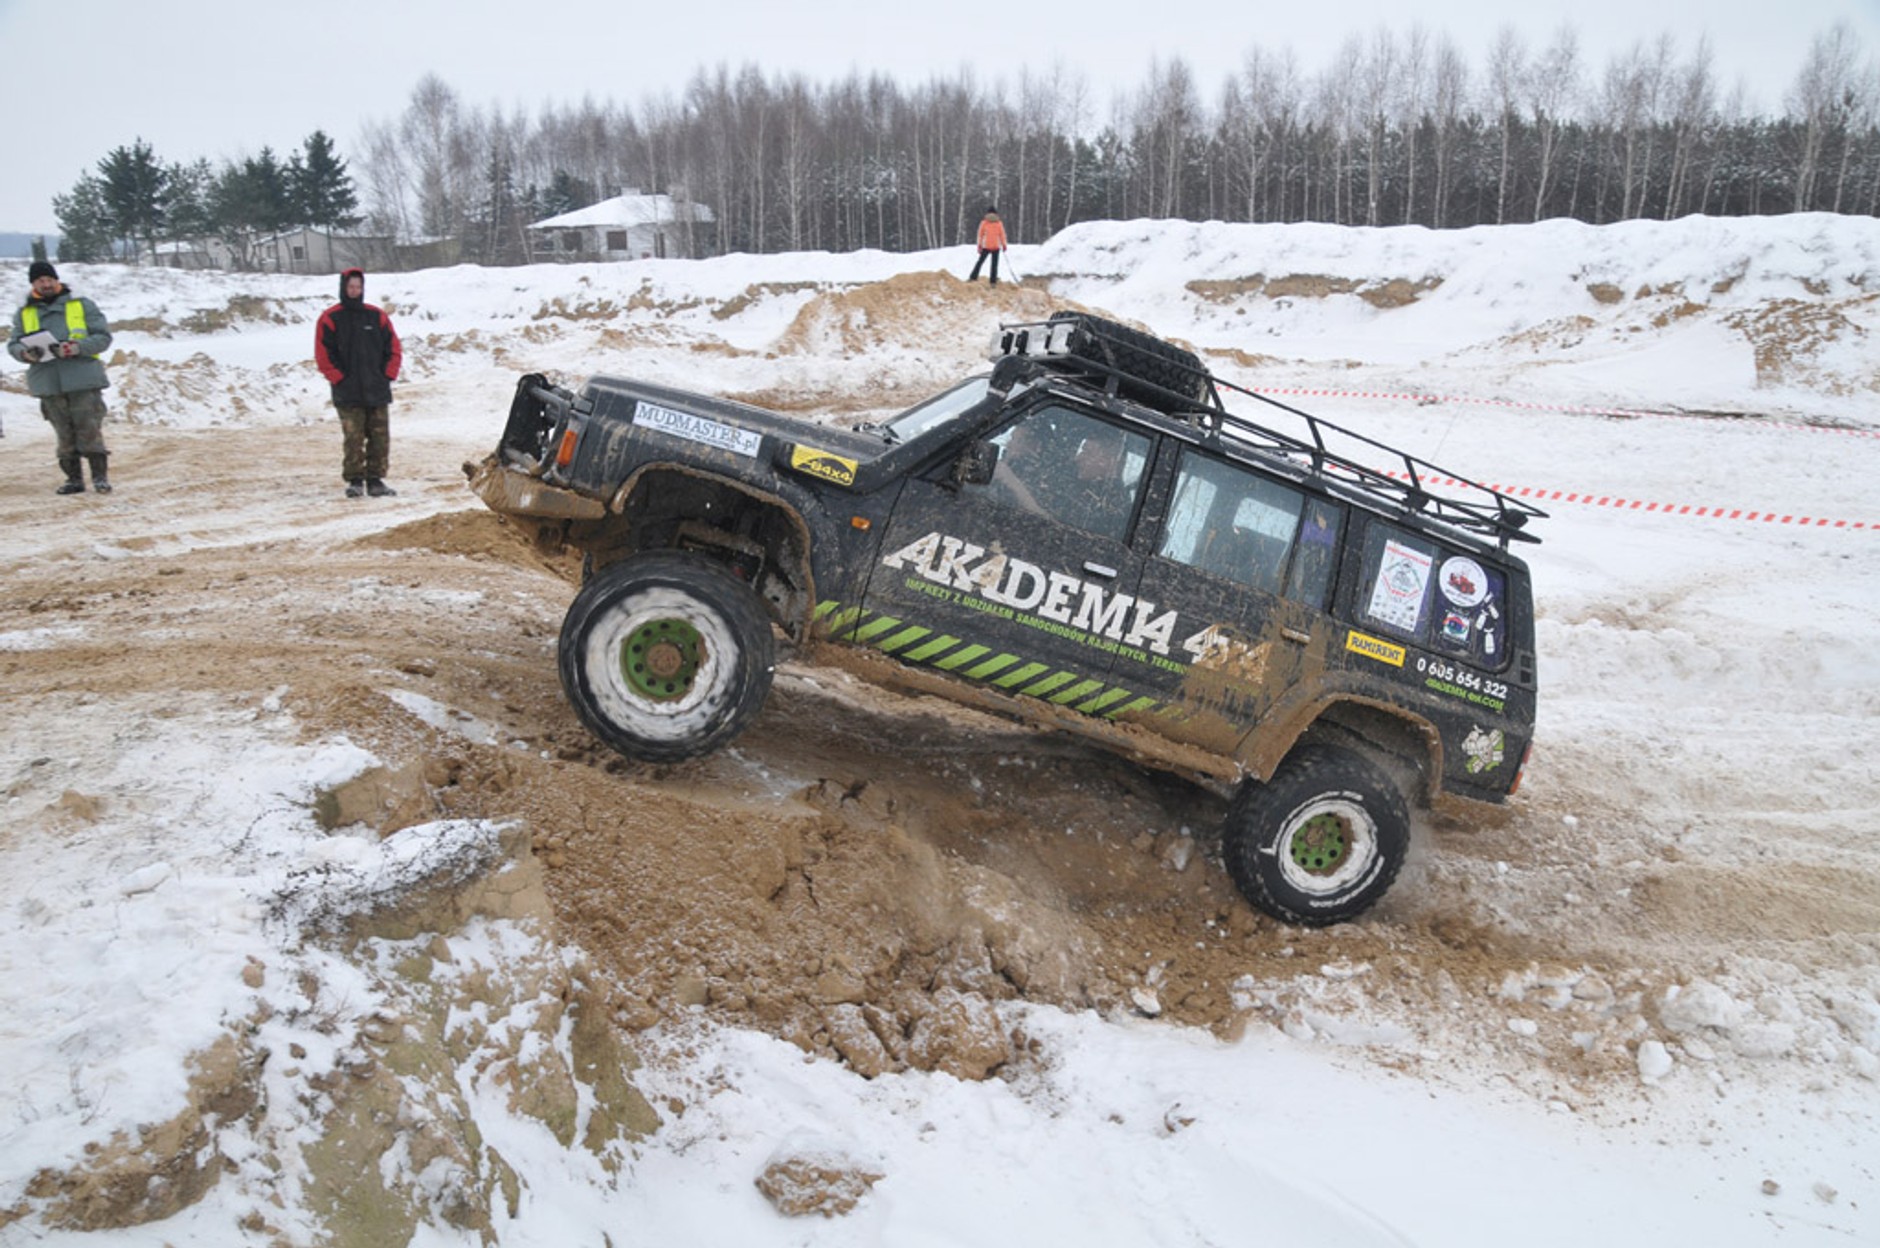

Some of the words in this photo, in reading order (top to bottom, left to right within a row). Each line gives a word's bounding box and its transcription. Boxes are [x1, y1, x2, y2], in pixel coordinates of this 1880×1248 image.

[637, 405, 758, 451] MUDMASTER.pl
[953, 594, 961, 604] Z
[1351, 636, 1401, 661] RAMIRENT
[1417, 657, 1427, 672] 0
[1428, 662, 1454, 681] 605
[1456, 671, 1482, 691] 654
[1483, 681, 1509, 699] 322
